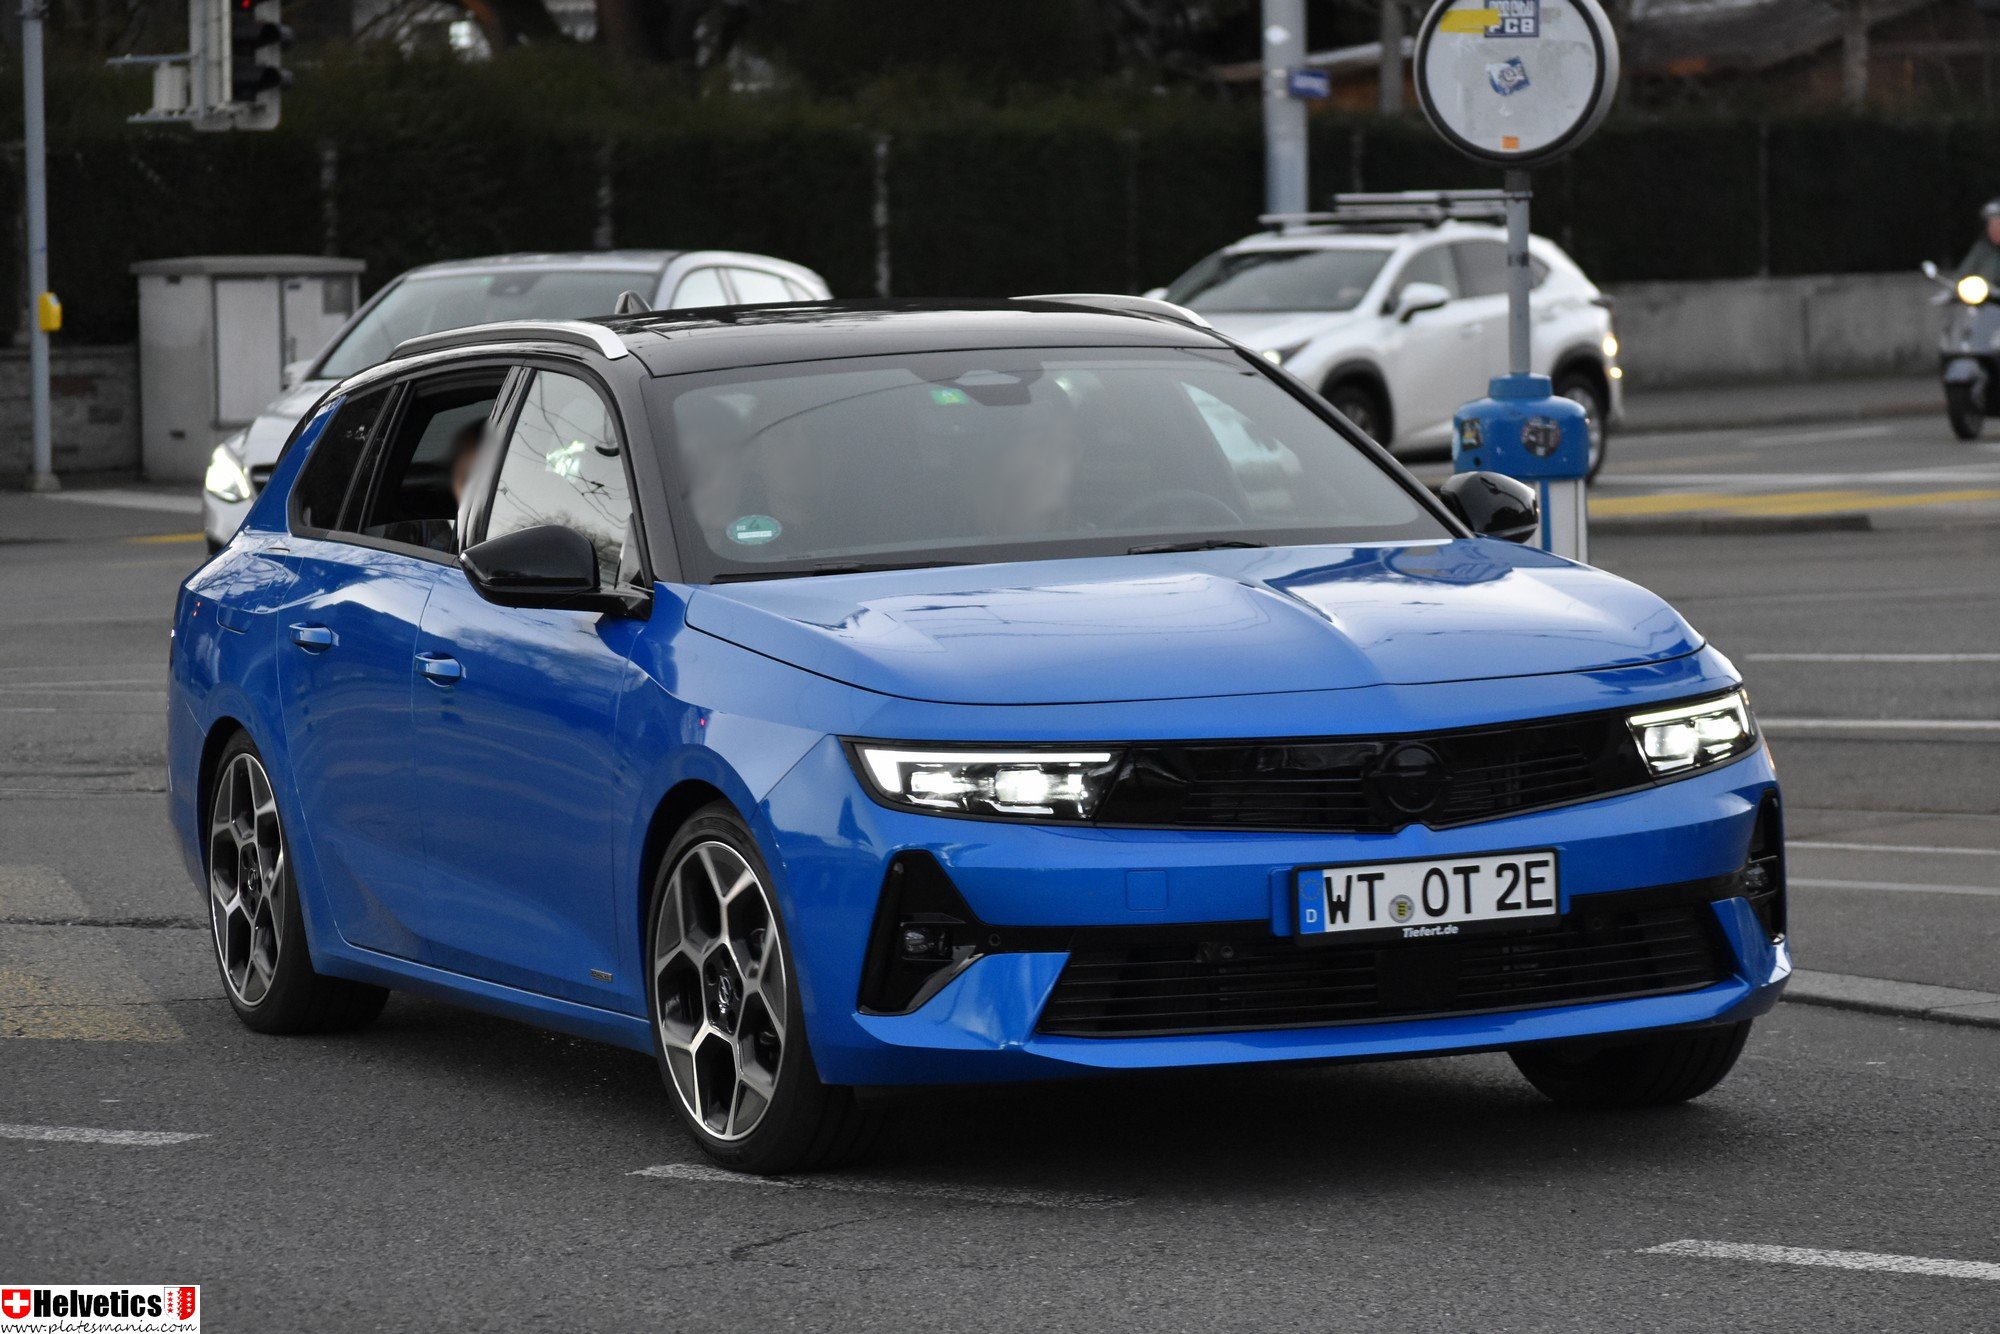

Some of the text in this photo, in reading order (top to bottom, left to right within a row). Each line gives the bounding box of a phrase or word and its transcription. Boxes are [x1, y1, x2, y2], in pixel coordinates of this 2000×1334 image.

[1325, 859, 1553, 925] WT OT 2E
[1306, 909, 1318, 923] D
[1402, 924, 1459, 938] Tiefert.de
